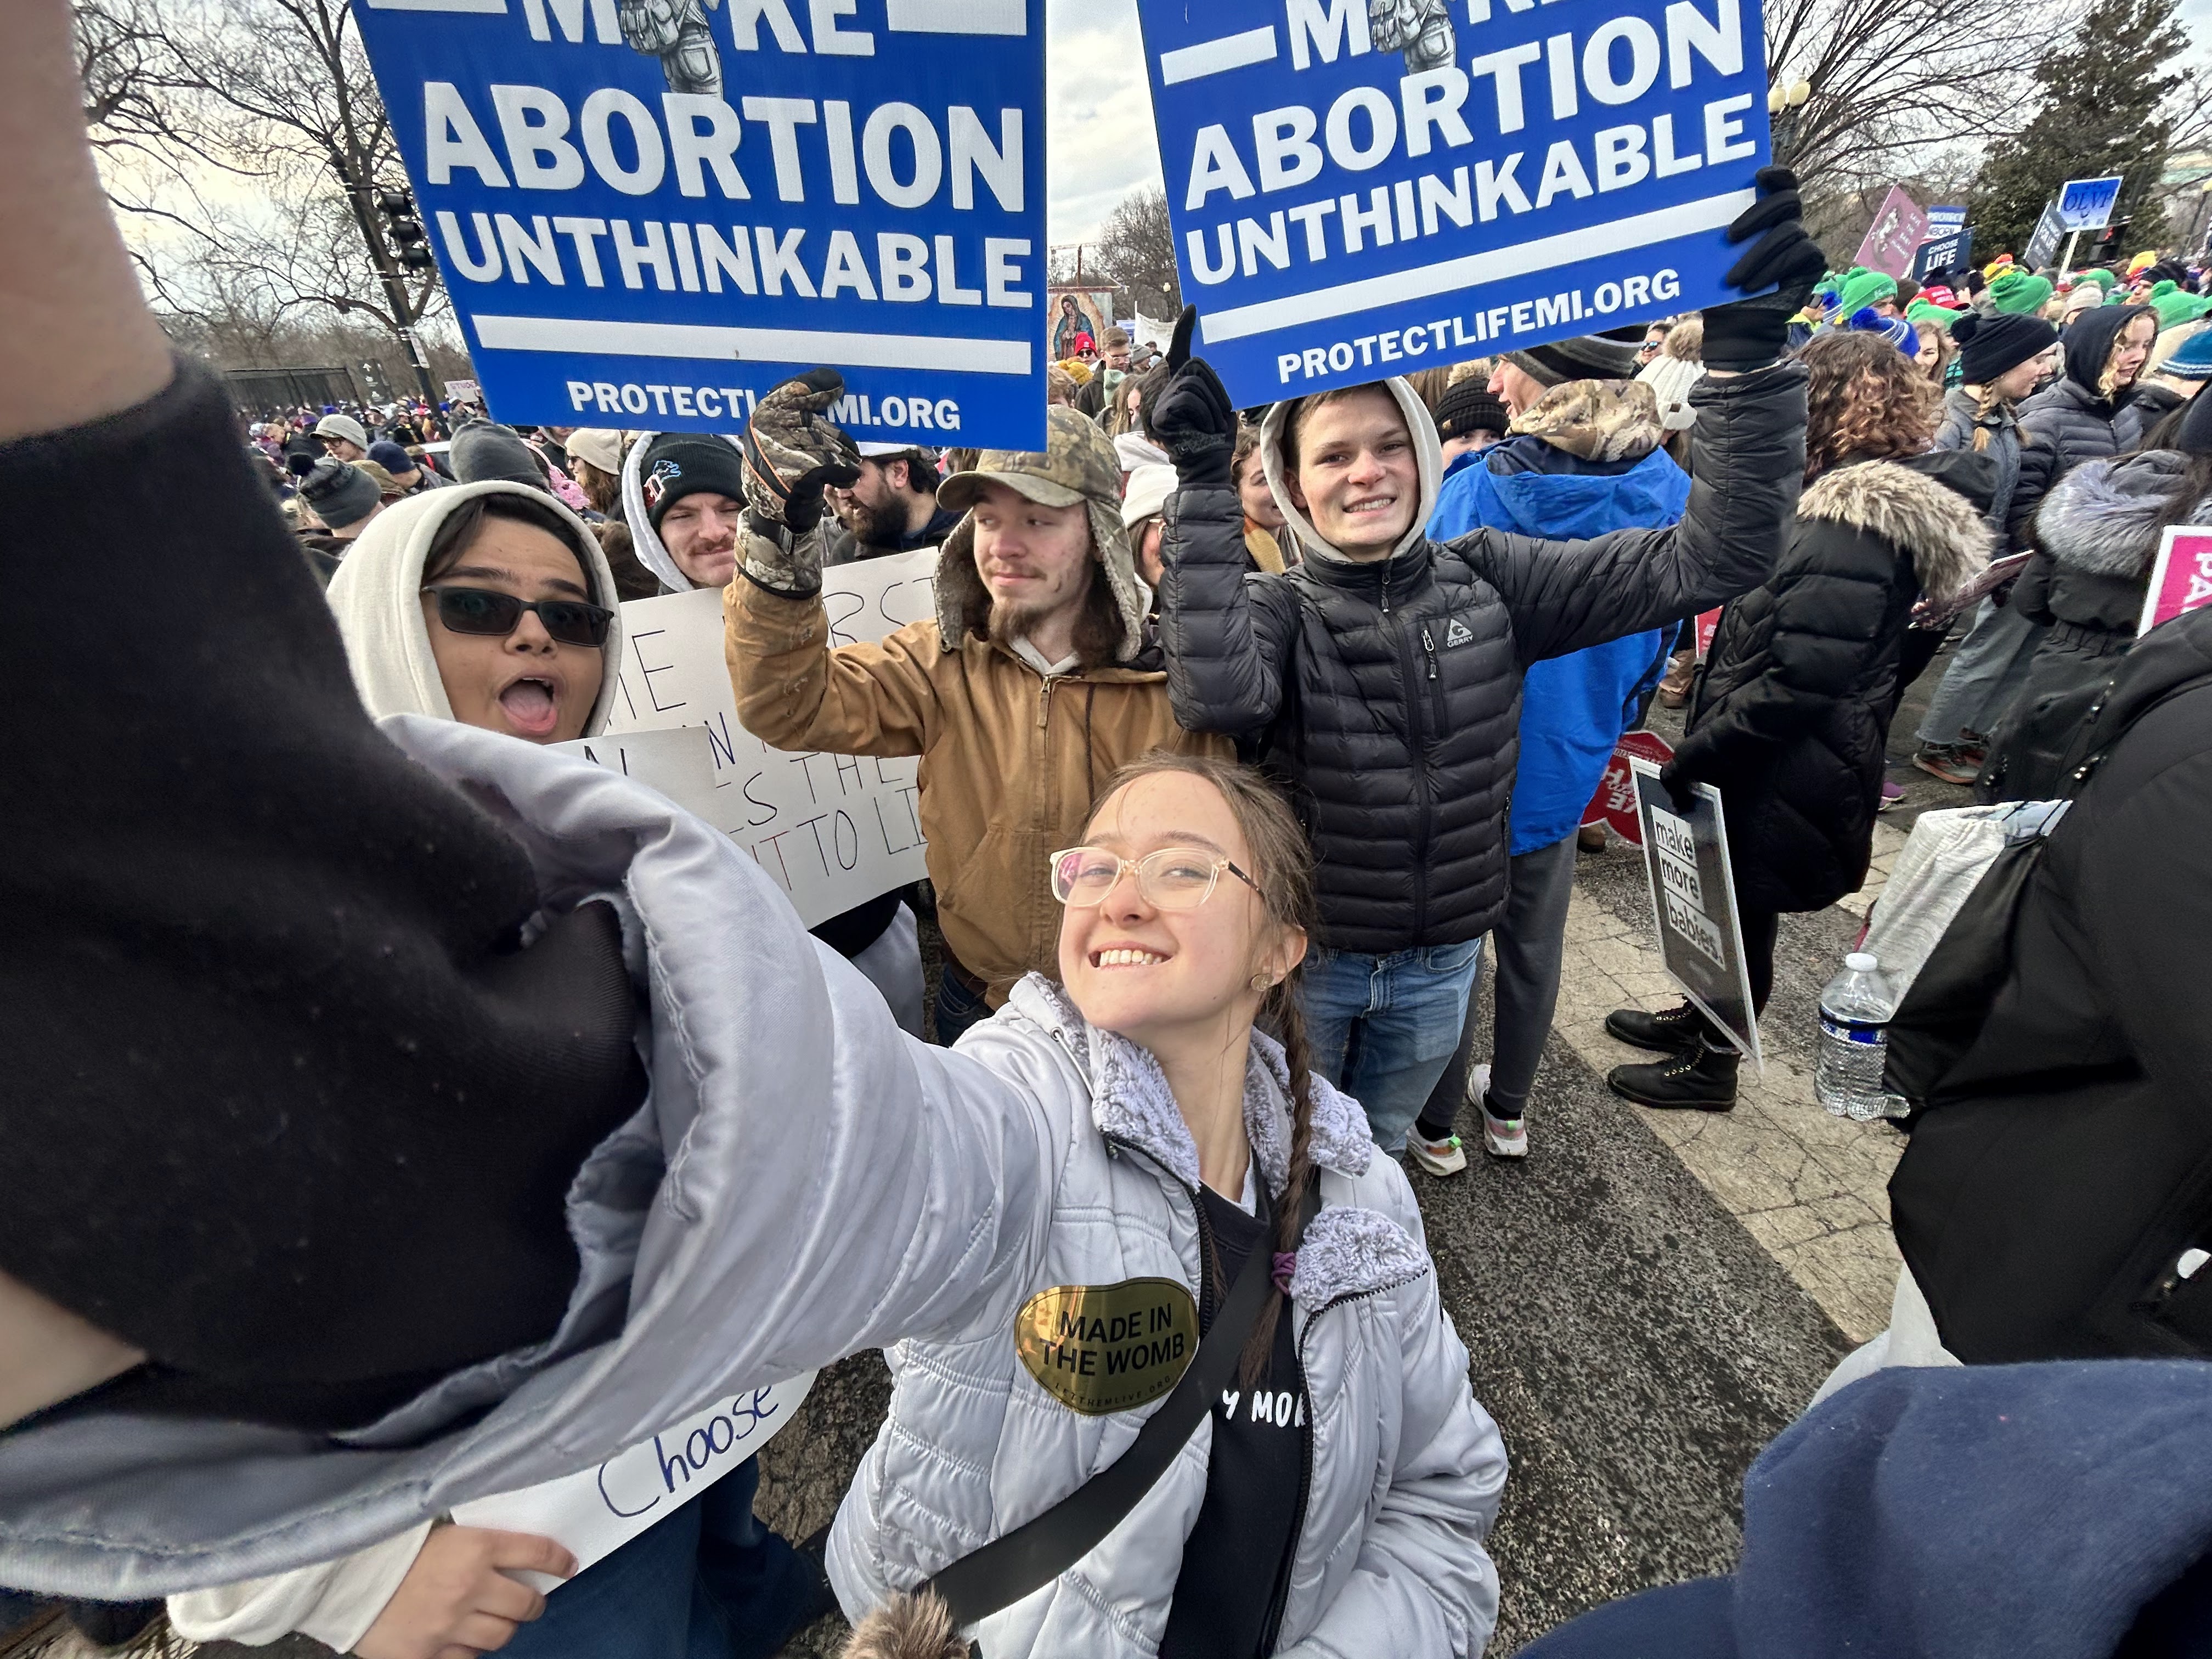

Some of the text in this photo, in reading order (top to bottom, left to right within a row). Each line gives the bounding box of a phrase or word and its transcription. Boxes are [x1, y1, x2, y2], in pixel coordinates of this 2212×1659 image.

[1185, 0, 1744, 211] ABORTION
[424, 81, 1024, 212] ABORTION
[1186, 92, 1756, 286] UNTHINKABLE
[435, 210, 1032, 308] UNTHINKABLE
[1925, 247, 1957, 273] LIFE
[1277, 268, 1680, 385] PROTECTLIFEMI.ORG
[1447, 634, 1474, 648] GERRY
[796, 813, 858, 877] TO
[1655, 819, 1694, 861] make
[1661, 856, 1699, 900] more
[1059, 1302, 1172, 1344] MADE IN
[1039, 1331, 1184, 1376] THE WOMB
[1055, 1375, 1171, 1407] LETTHEMLIVE.ORG
